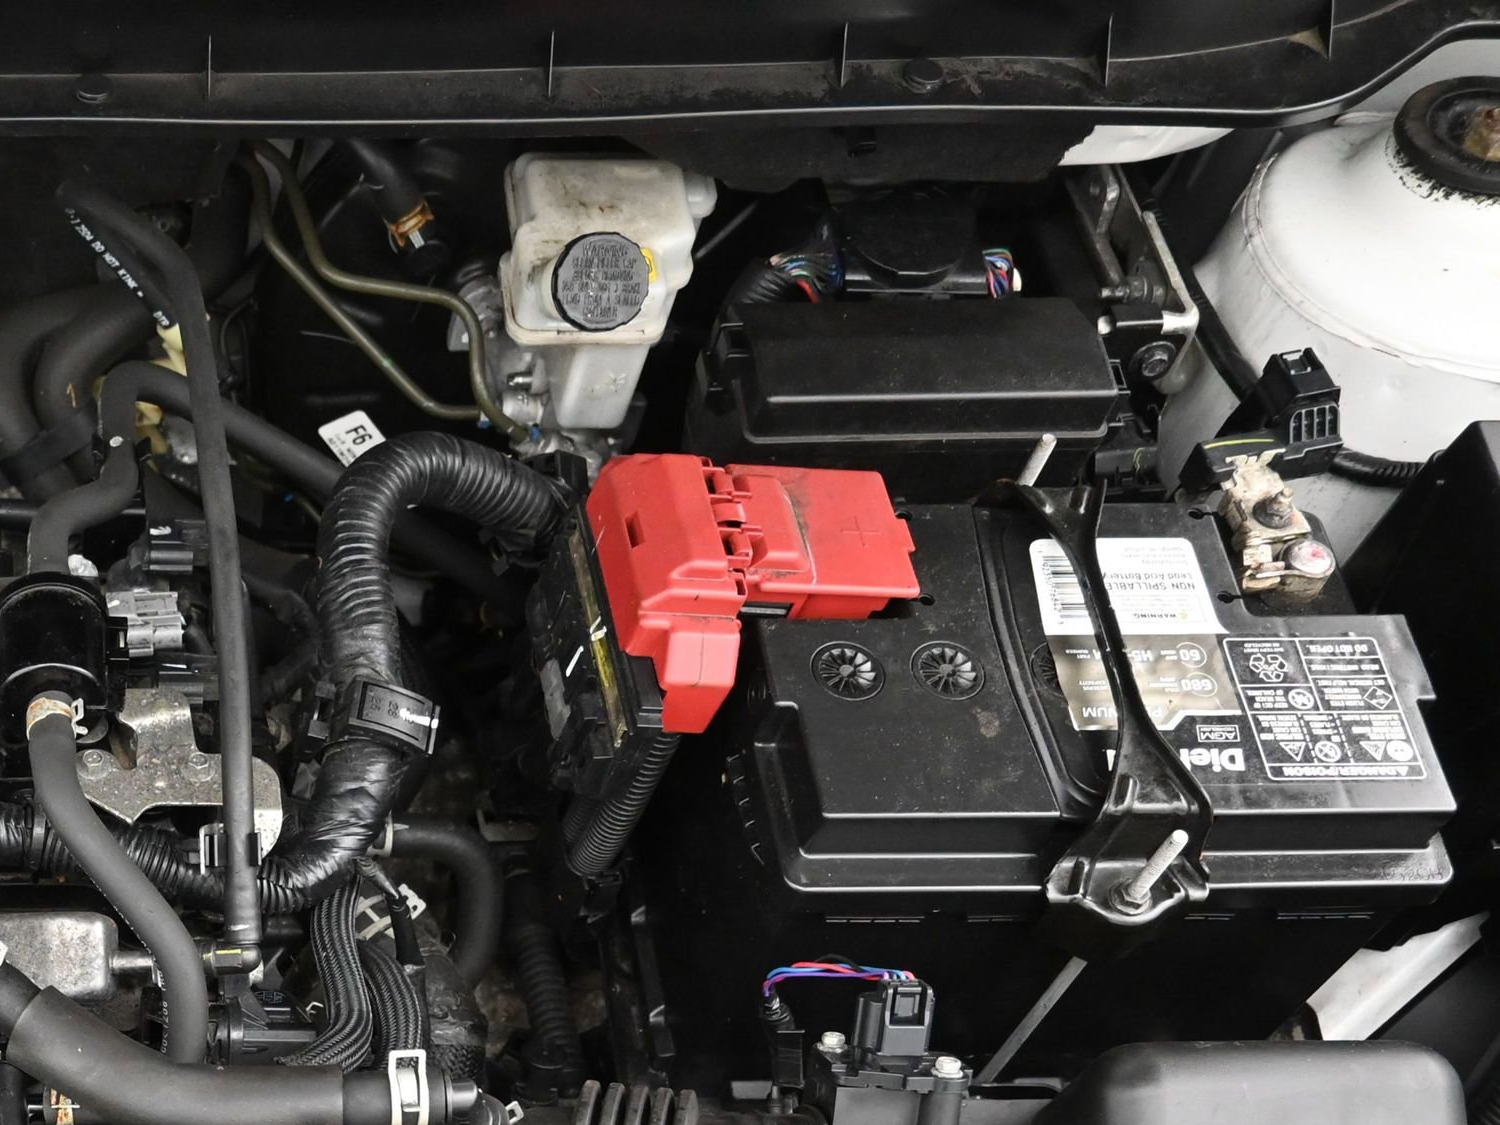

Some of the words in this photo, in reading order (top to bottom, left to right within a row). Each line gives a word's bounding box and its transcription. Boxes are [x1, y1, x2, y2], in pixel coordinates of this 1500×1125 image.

[345, 425, 373, 446] F6
[1144, 572, 1164, 580] Acid
[1106, 582, 1167, 590] SPILLABLE
[1171, 582, 1195, 590] NON
[1179, 650, 1201, 661] 60
[1181, 679, 1214, 691] 680
[1199, 731, 1237, 740] AGM
